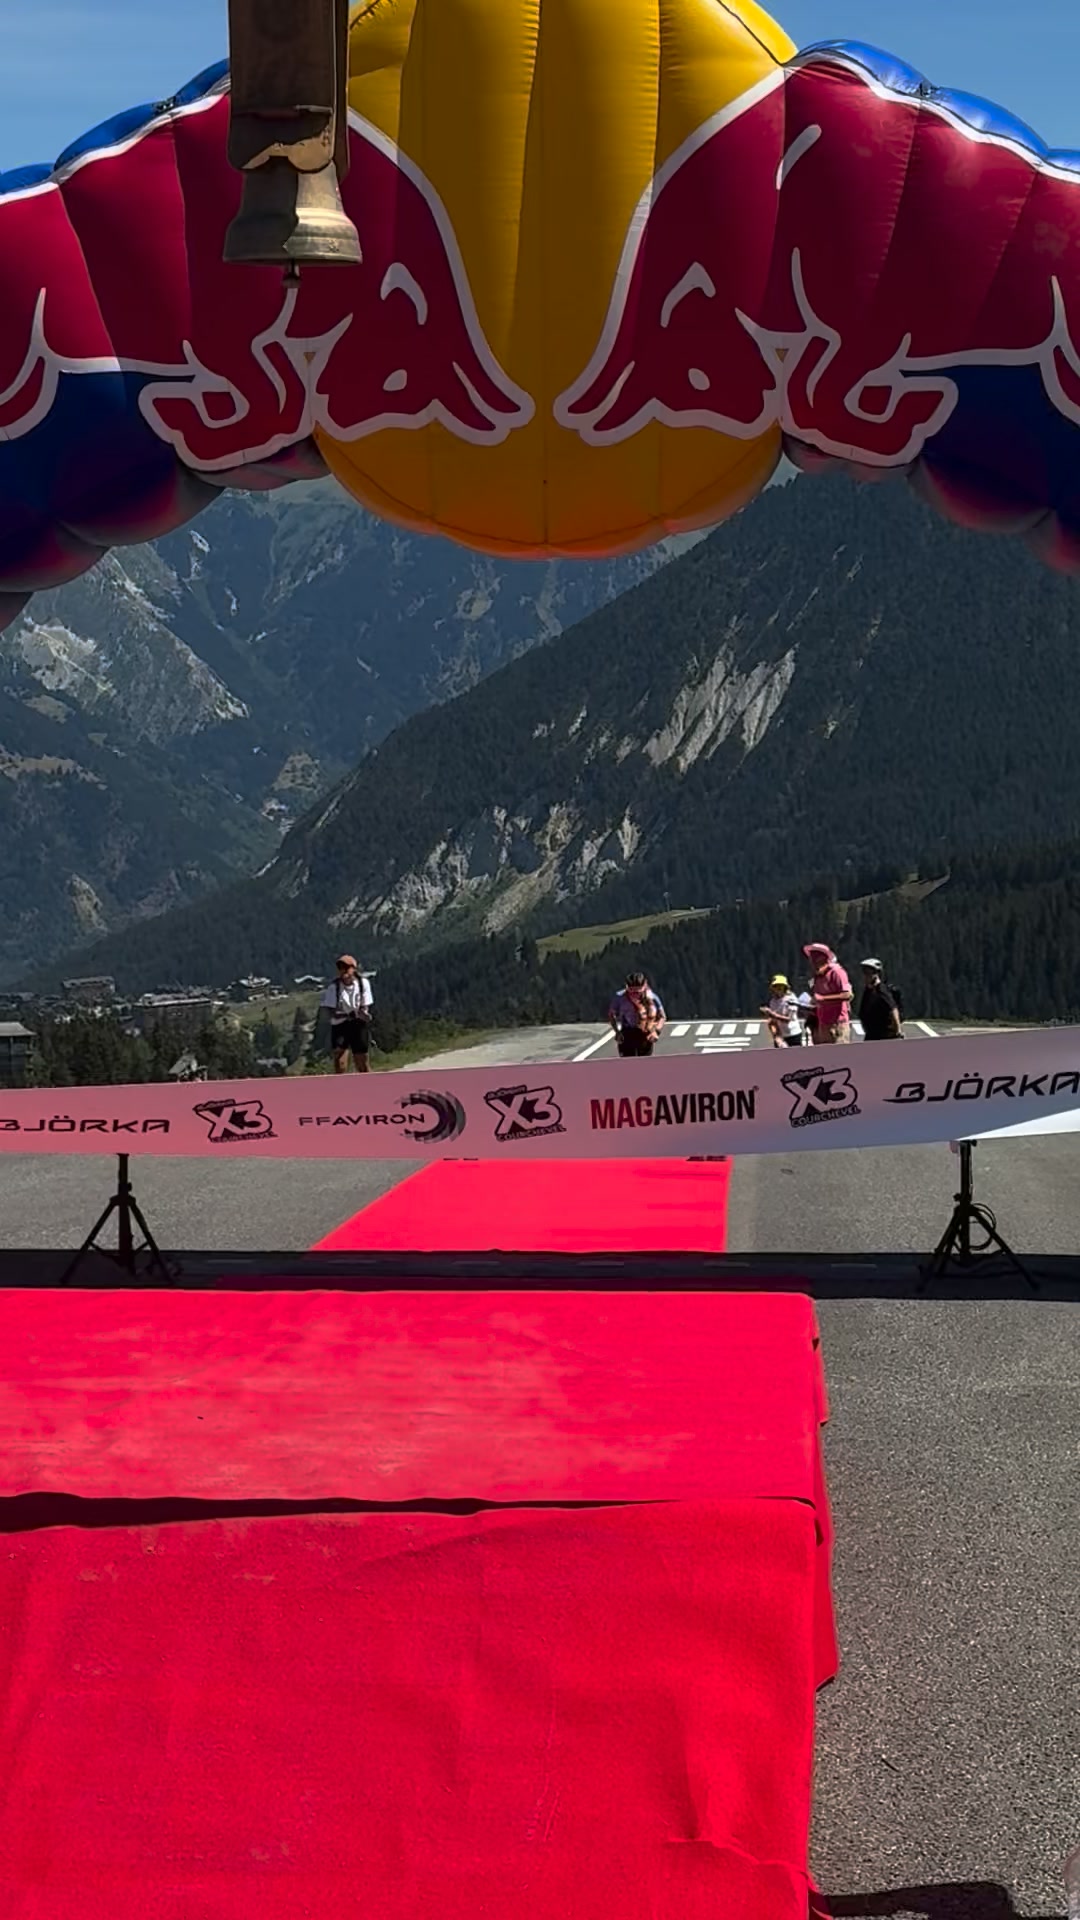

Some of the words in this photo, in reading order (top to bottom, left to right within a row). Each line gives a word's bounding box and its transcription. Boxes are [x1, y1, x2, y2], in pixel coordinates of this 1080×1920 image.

[781, 1067, 858, 1120] X3
[883, 1072, 1080, 1103] BJÖRKA
[196, 1100, 273, 1140] X3
[299, 1113, 425, 1126] FFAVIRON
[486, 1086, 562, 1136] X3
